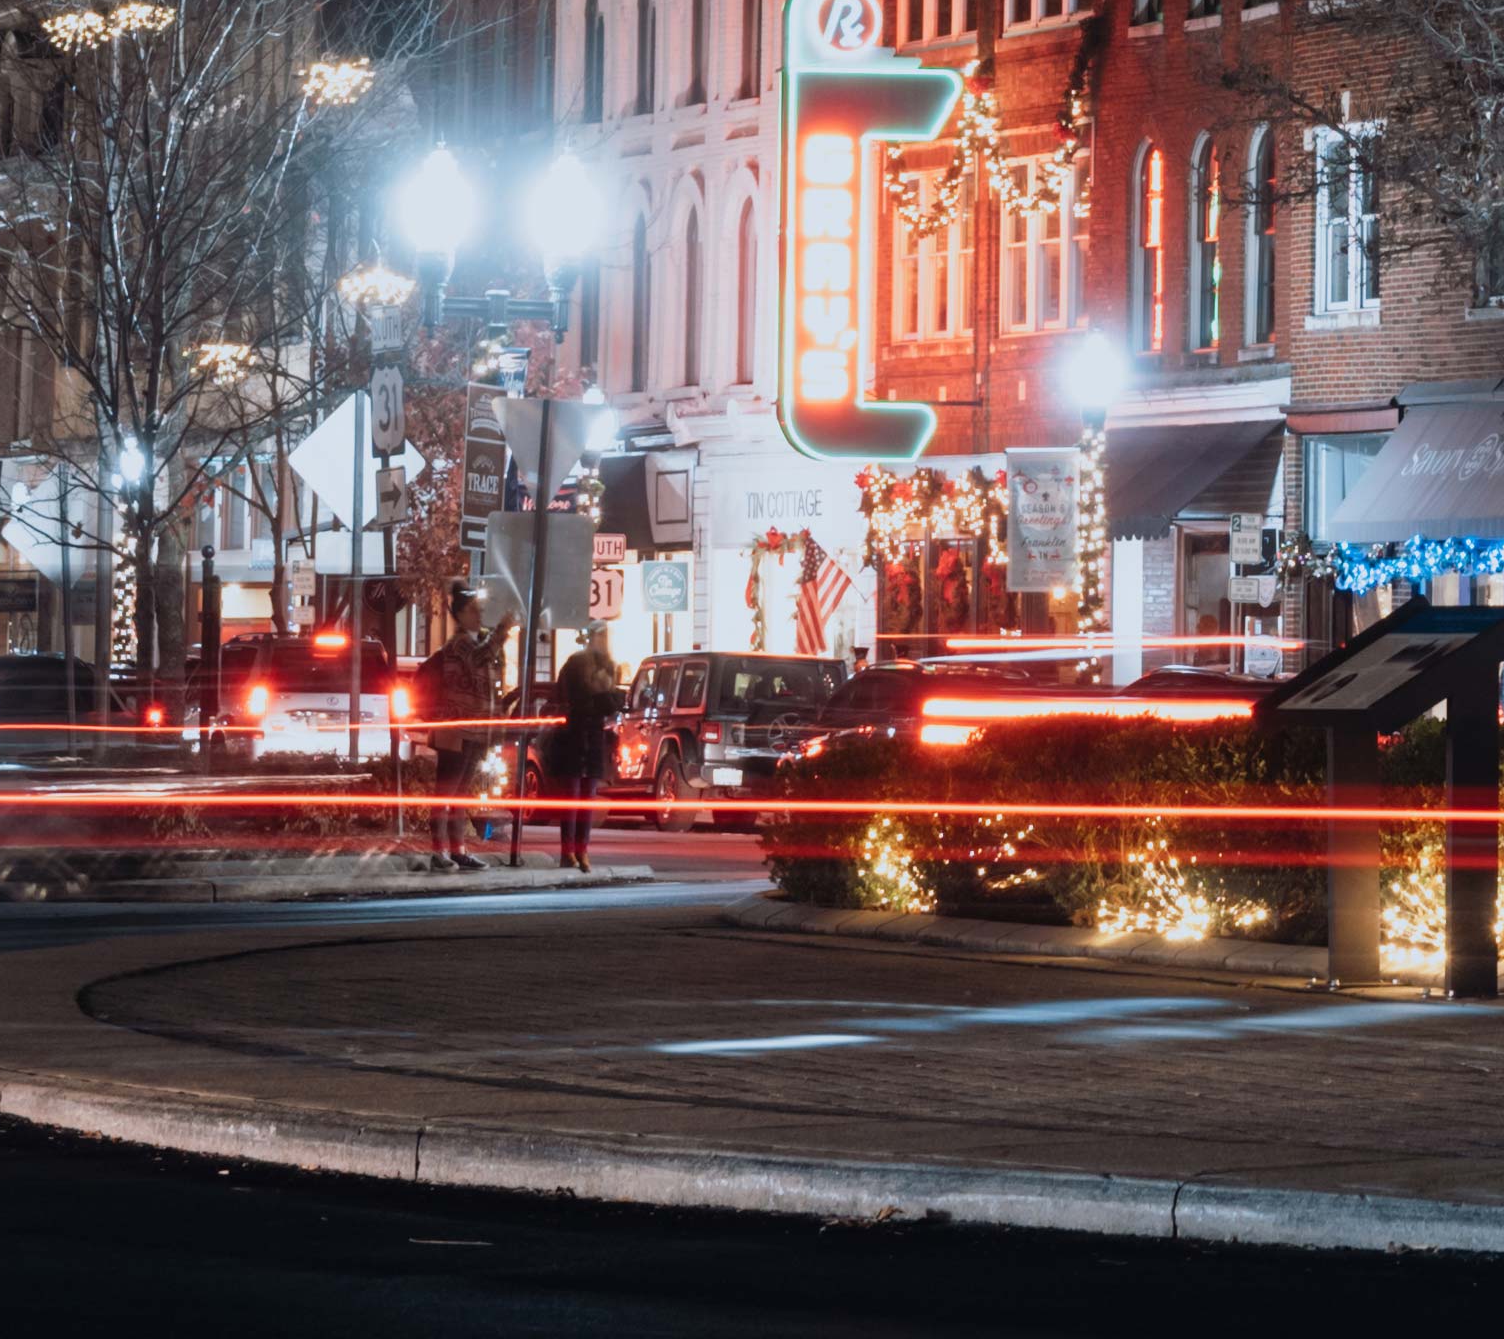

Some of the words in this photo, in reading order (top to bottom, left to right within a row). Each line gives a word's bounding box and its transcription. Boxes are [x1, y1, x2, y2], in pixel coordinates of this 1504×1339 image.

[800, 133, 859, 401] GRAY'S
[378, 384, 399, 433] 31
[1401, 443, 1466, 480] Savory
[467, 472, 499, 495] TRACE
[746, 491, 764, 519] TIN
[767, 489, 823, 519] COTTAGE
[1021, 503, 1066, 514] SEASONS
[1233, 517, 1241, 530] 2
[596, 540, 623, 556] UTH
